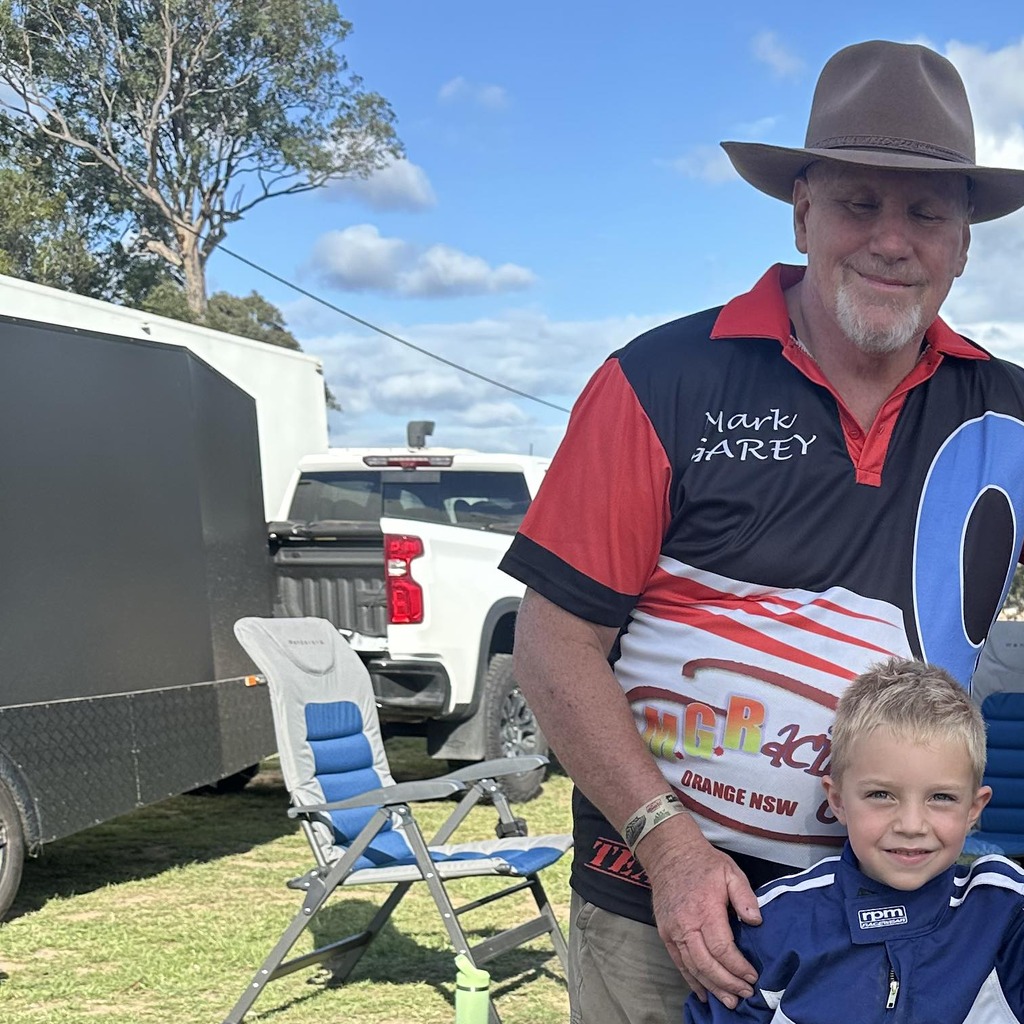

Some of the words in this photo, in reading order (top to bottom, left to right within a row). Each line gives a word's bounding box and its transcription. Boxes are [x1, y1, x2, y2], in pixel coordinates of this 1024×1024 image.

[704, 408, 798, 432] Mark
[681, 769, 747, 806] ORANGE
[748, 791, 799, 817] NSW
[587, 840, 652, 884] TE
[862, 908, 904, 922] rpm
